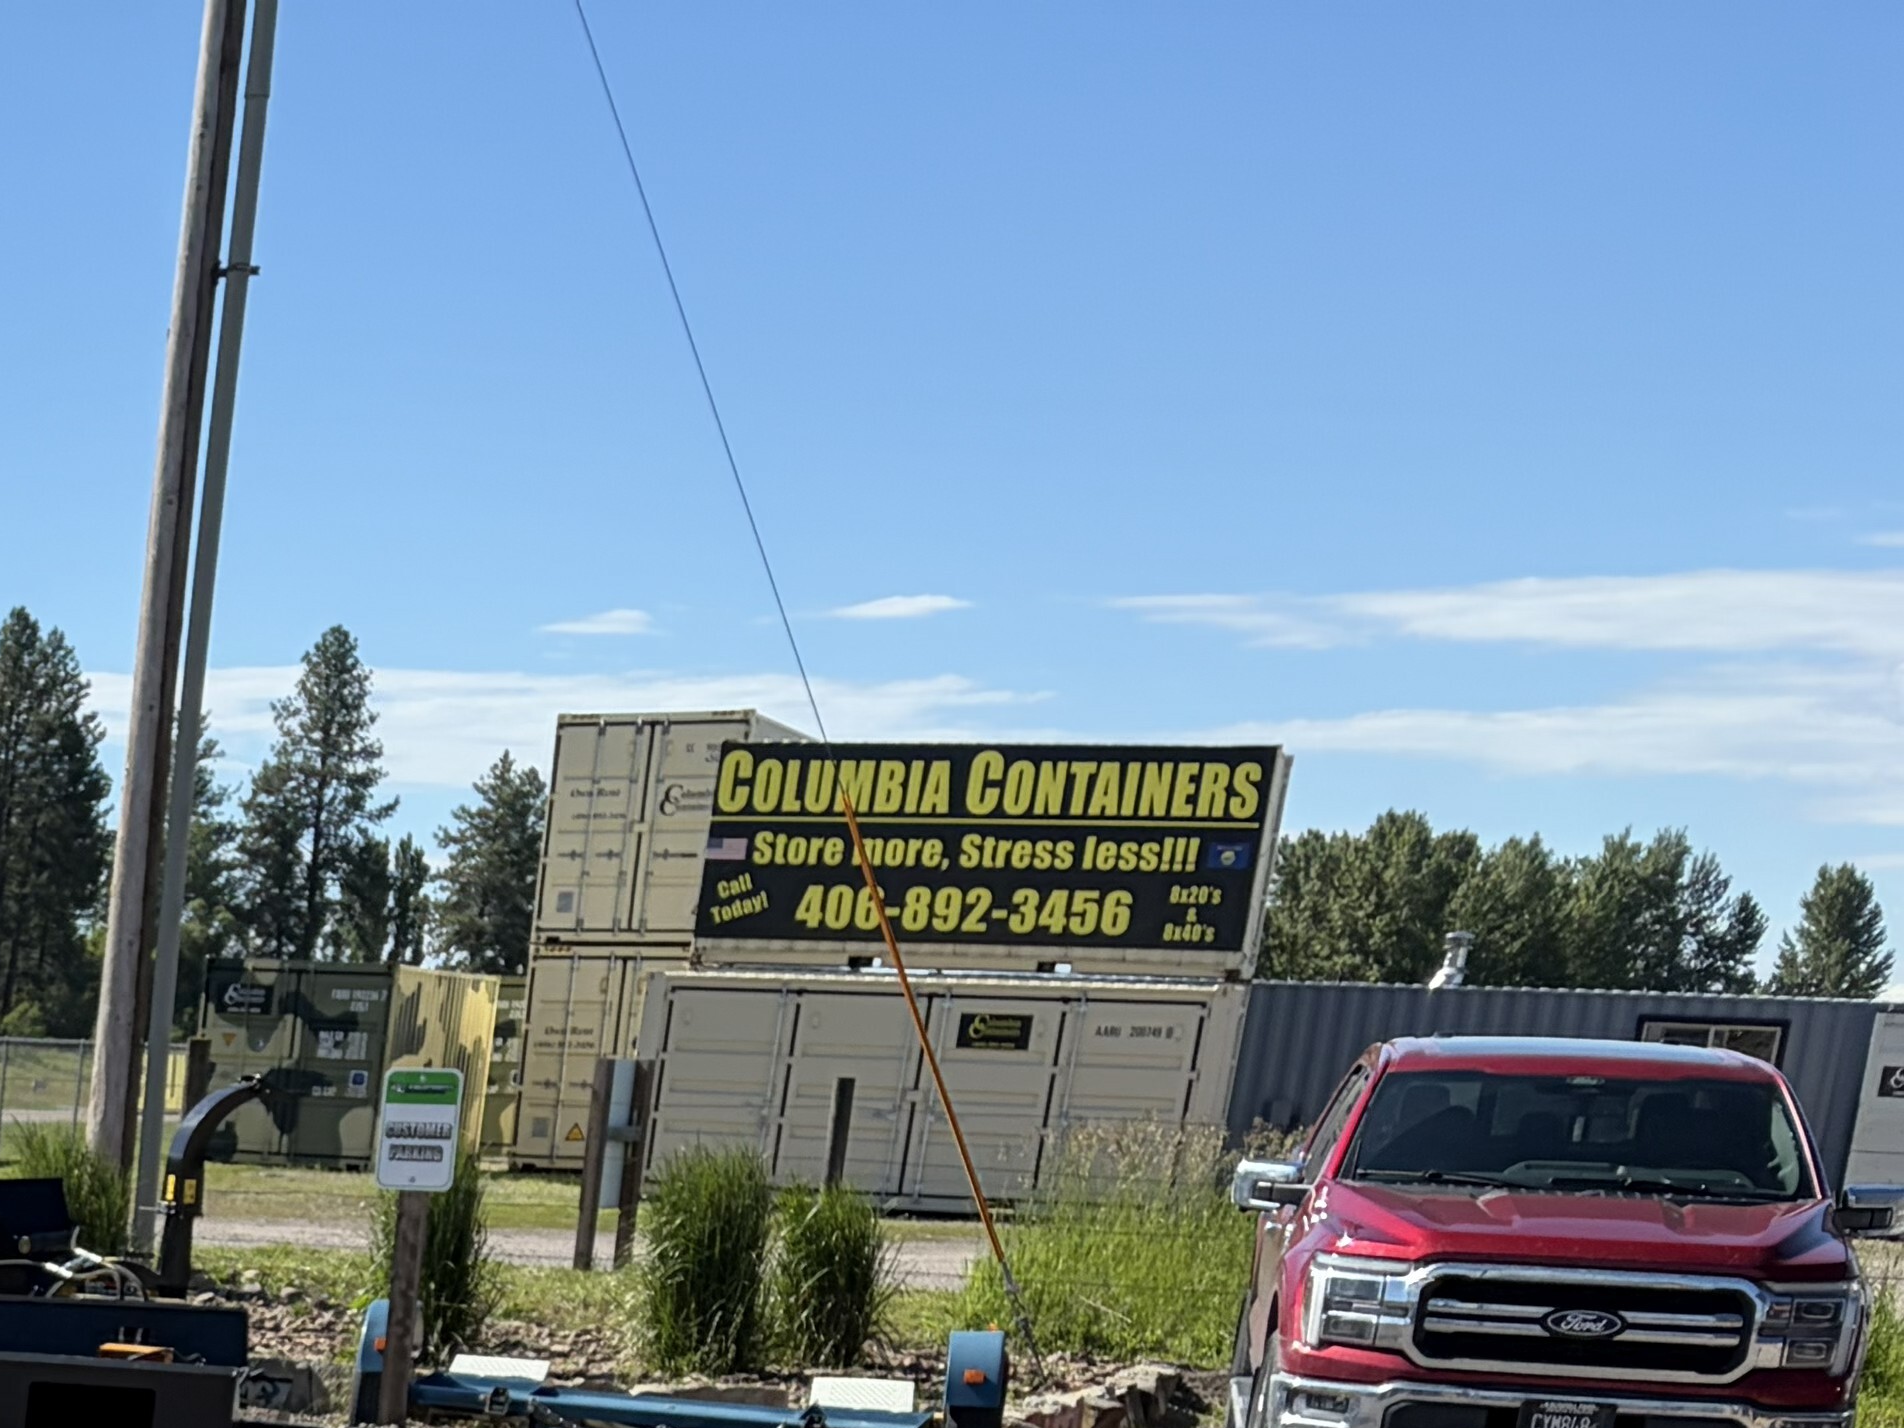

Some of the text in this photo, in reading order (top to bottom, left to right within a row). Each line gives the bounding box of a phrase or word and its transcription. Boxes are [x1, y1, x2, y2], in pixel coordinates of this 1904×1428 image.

[717, 749, 1262, 819] COLUMBIA CONTAINERS
[752, 830, 1201, 873] Store more, Stress less!!!
[717, 872, 753, 900] Call
[1169, 884, 1223, 905] 8x20's
[710, 890, 769, 925] Today!
[795, 884, 1133, 937] 406-892-3456
[1185, 906, 1198, 923] &
[1162, 922, 1216, 943] 8x40's
[385, 1121, 453, 1140] CUSTOMER
[389, 1144, 444, 1162] PARKING
[1560, 1313, 1608, 1331] Ford
